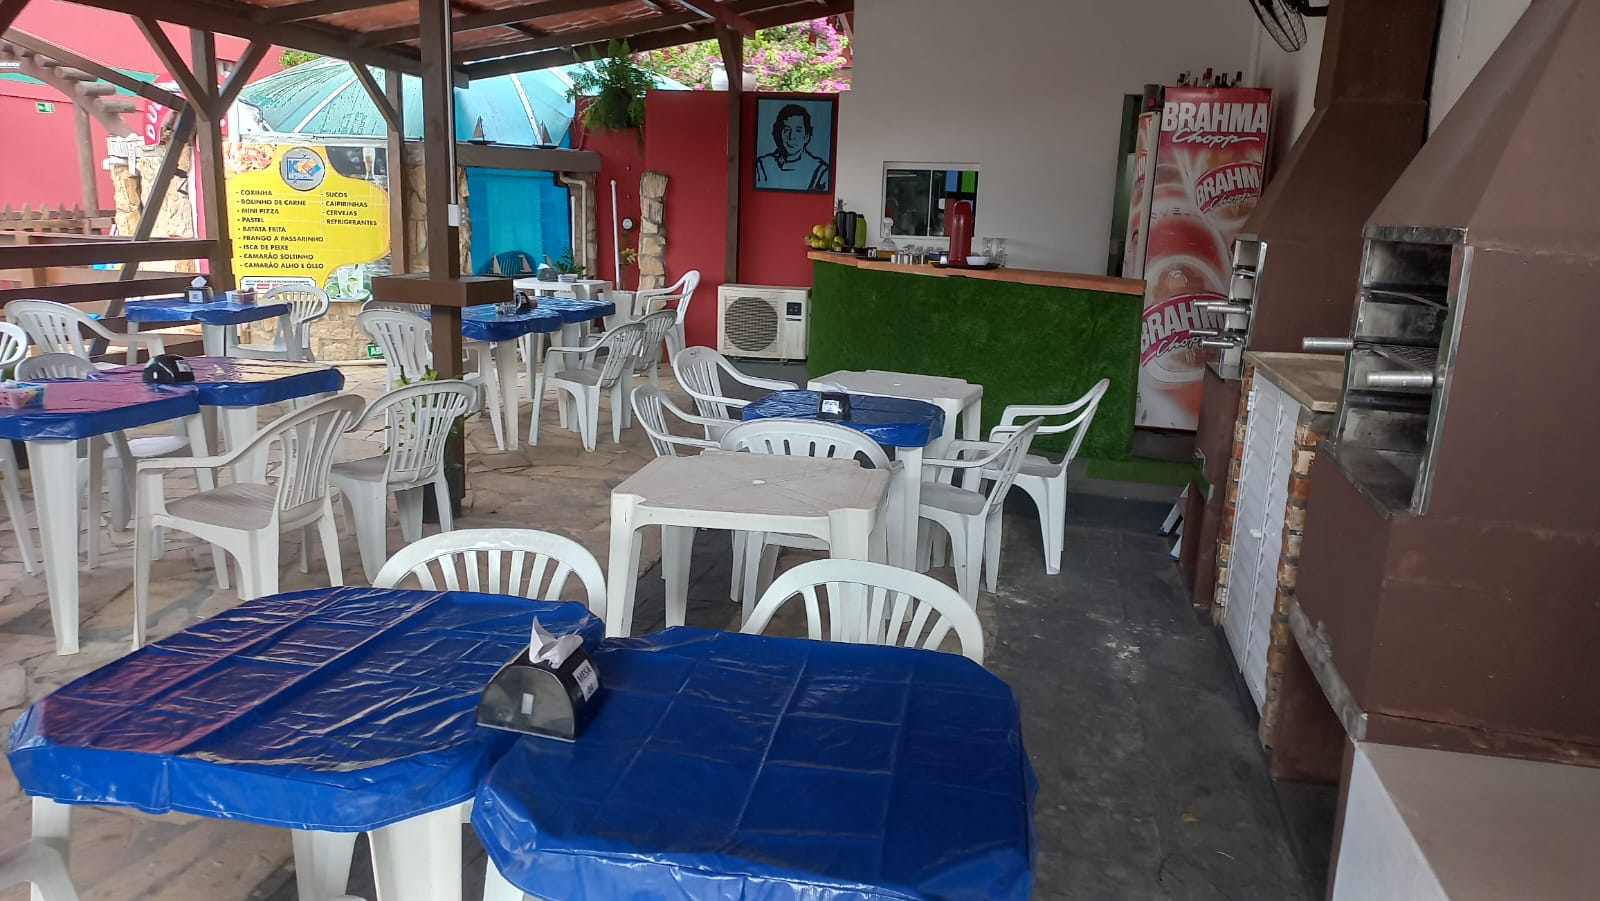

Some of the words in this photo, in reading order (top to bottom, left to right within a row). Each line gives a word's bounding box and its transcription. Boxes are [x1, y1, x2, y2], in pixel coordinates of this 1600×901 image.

[1161, 102, 1268, 133] BRAHMA
[1172, 128, 1260, 149] Chopp
[1196, 167, 1261, 208] BRAHM
[326, 218, 378, 226] REFRIGERANTES
[1141, 301, 1227, 353] BRAHM
